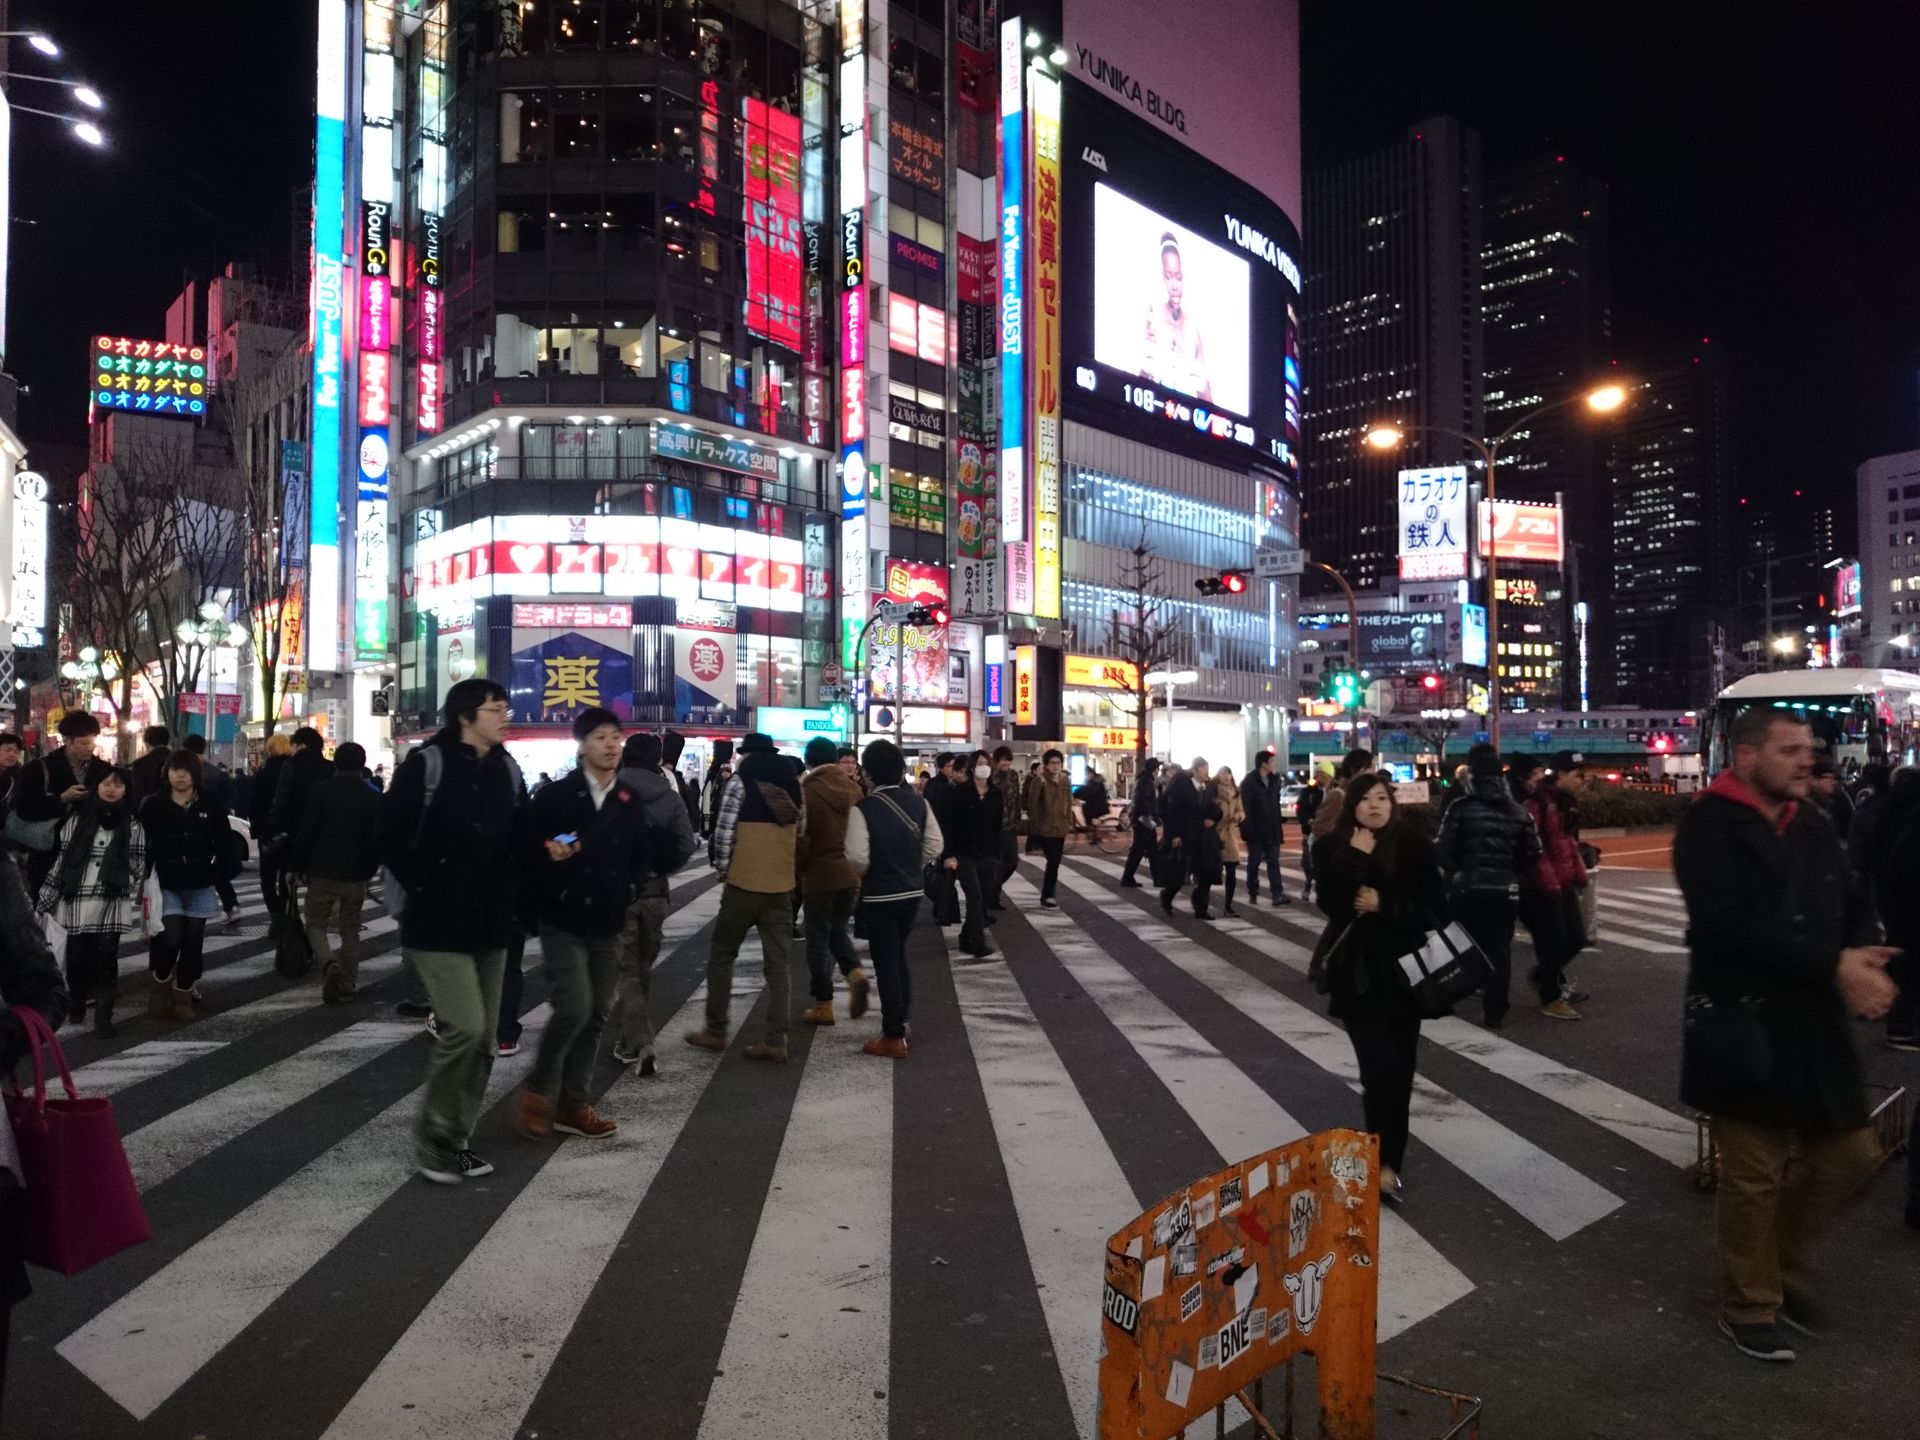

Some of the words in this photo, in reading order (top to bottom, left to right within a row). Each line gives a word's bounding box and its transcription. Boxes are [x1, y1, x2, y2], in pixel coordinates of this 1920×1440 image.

[1076, 43, 1143, 106] YUNIKA
[1147, 90, 1188, 136] BLDG.
[892, 156, 941, 191] マッサージ
[902, 145, 932, 170] オイル
[367, 202, 387, 274] RounGe
[846, 211, 861, 286] RounGe
[1224, 214, 1276, 266] YUNIKA
[897, 242, 938, 270] PROMISE
[1038, 164, 1057, 414] 決算セール
[115, 338, 187, 360] オカダヤ
[116, 356, 187, 378] オカダヤ
[116, 373, 187, 395] オカダヤ
[116, 391, 187, 413] オカダヤ
[659, 430, 777, 474] 高興リラックス空間
[1402, 472, 1462, 503] カラオケ
[1426, 504, 1437, 520] の
[1408, 521, 1456, 549] 鉄人
[555, 545, 650, 574] アイフル
[694, 643, 719, 675] 薬
[1371, 635, 1408, 653] global
[543, 655, 600, 709] 薬
[990, 666, 999, 703] PROMISE
[1020, 673, 1029, 712] 吉野家
[1220, 1318, 1249, 1364] BNE
